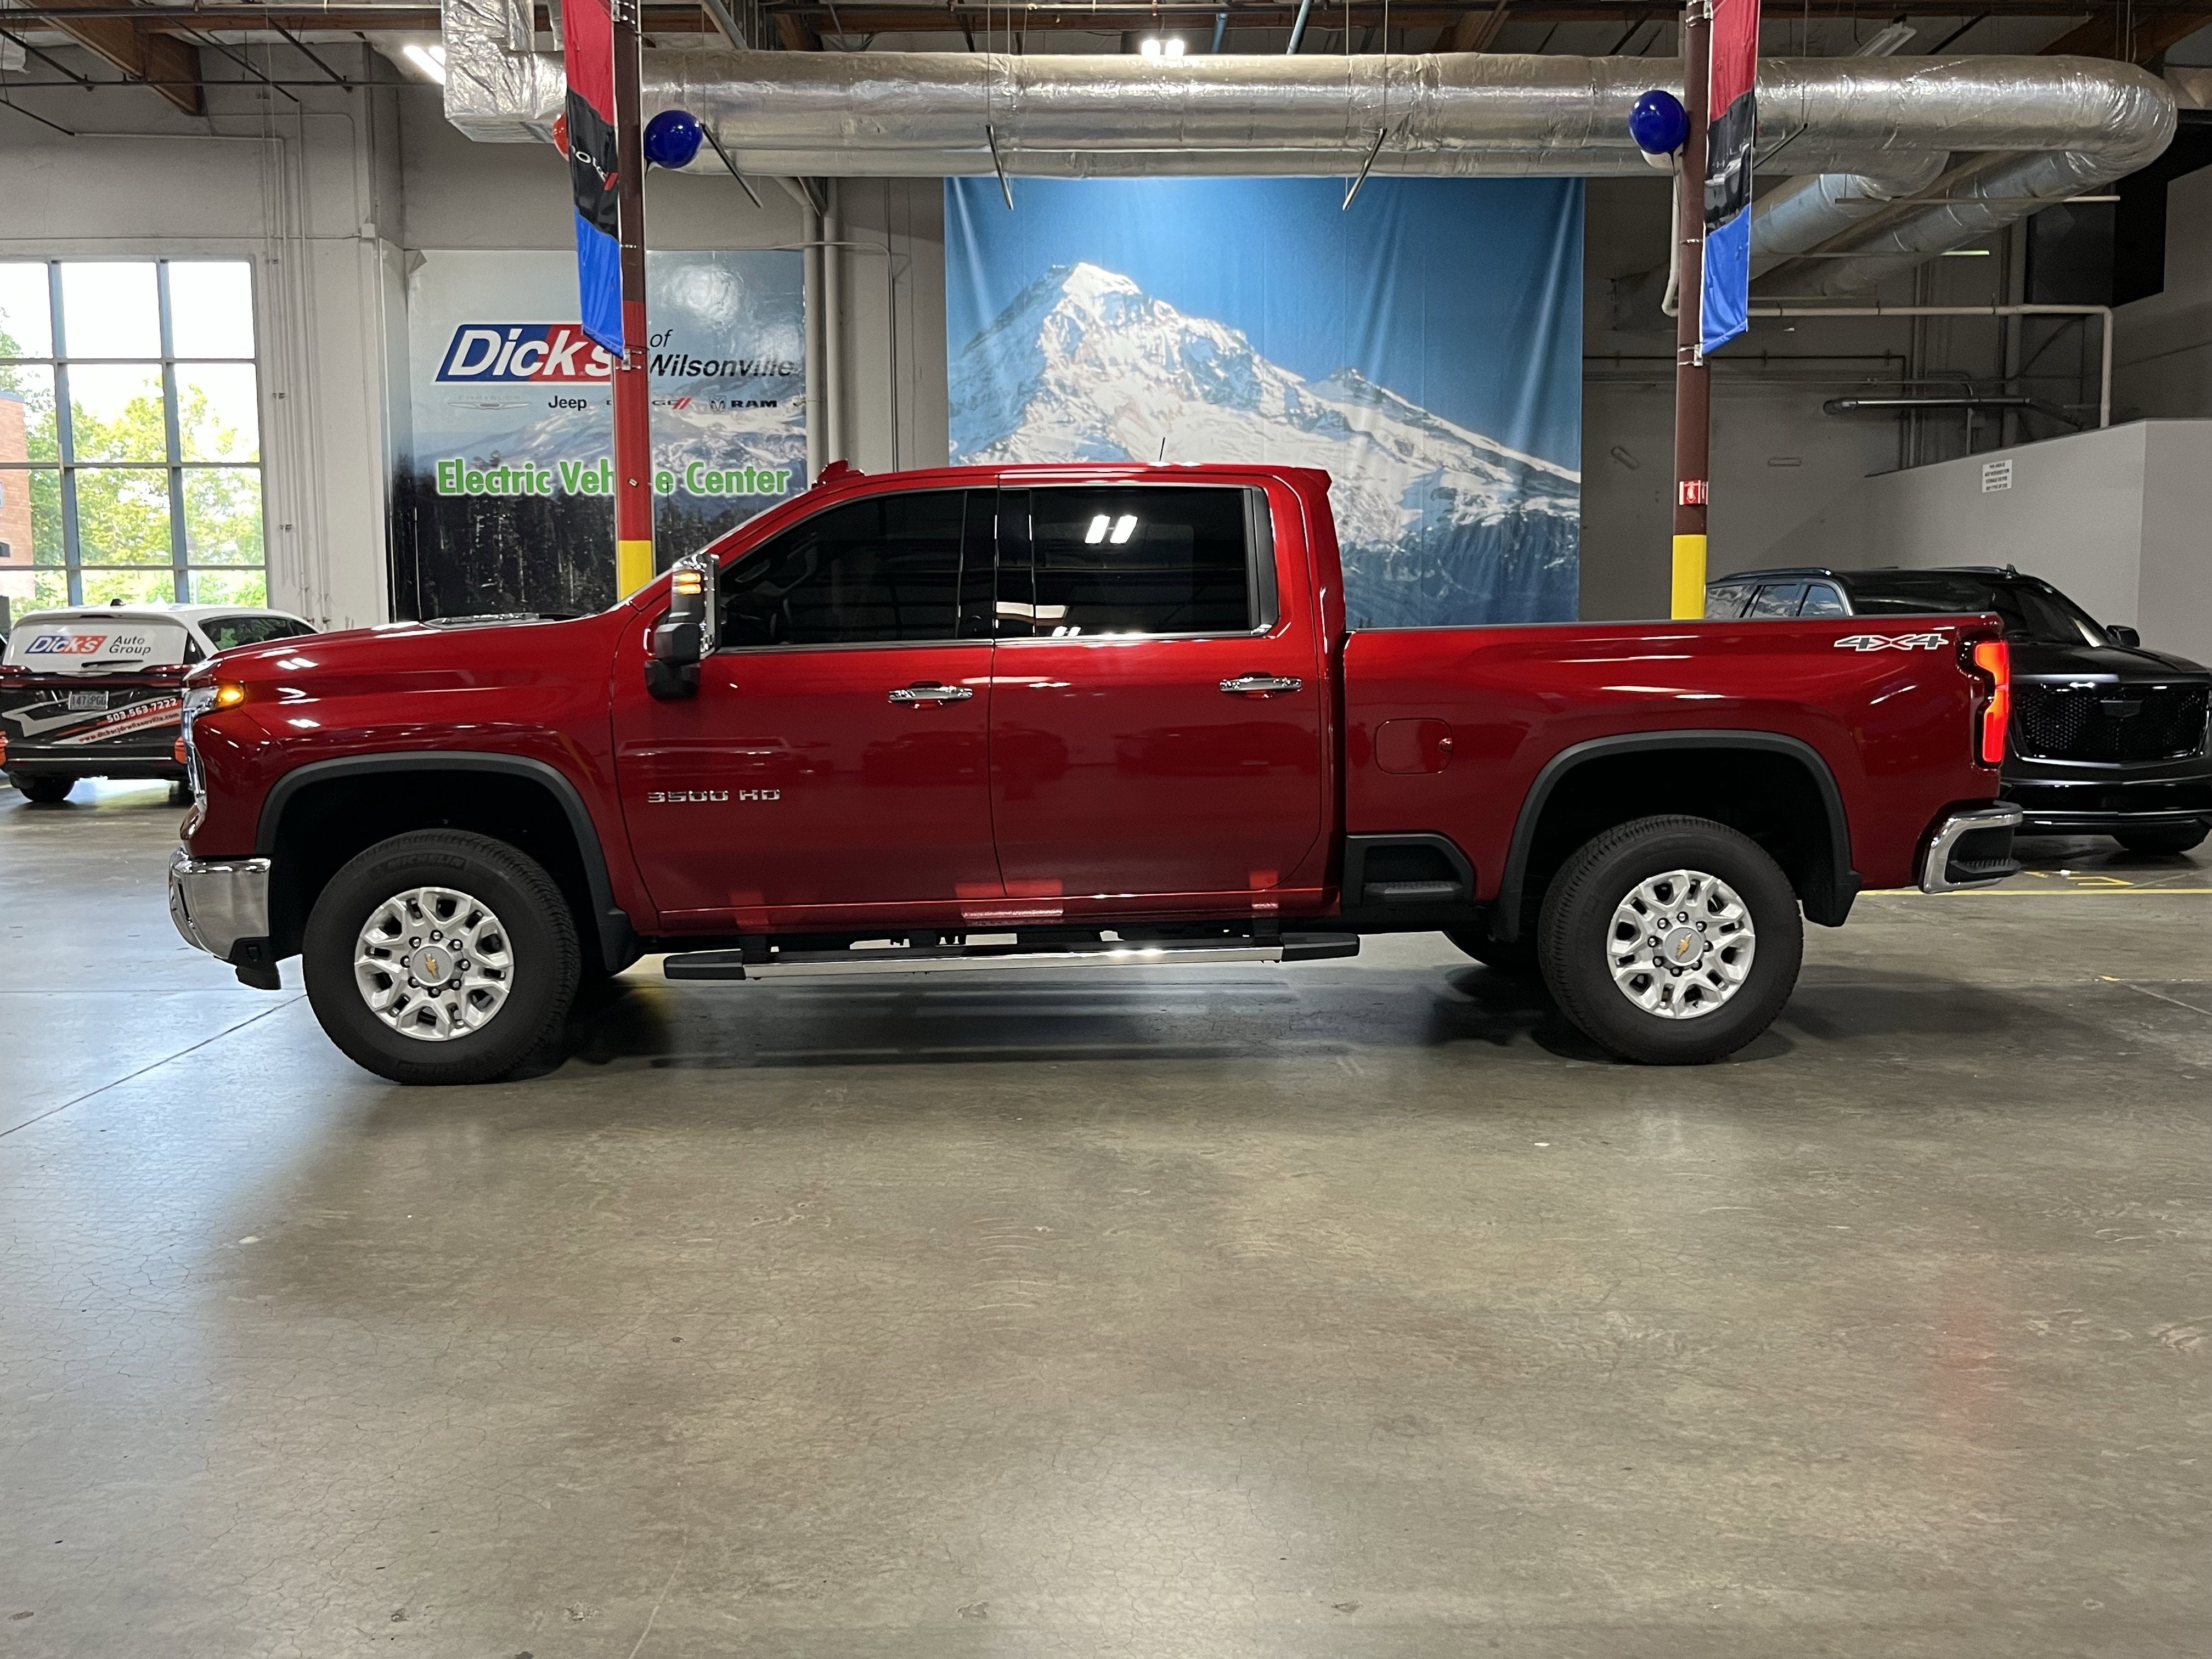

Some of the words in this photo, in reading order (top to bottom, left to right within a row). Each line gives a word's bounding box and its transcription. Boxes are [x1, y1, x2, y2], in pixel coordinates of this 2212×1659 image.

[650, 329, 673, 347] of
[448, 328, 611, 376] Dicks
[548, 396, 588, 411] Jeep
[438, 459, 550, 493] Electric
[560, 459, 674, 493] Vehe
[687, 461, 791, 493] Center
[29, 637, 99, 652] Dick's
[113, 636, 145, 645] Auto
[109, 644, 151, 656] Group
[648, 790, 729, 803] 3500
[739, 789, 780, 800] HD
